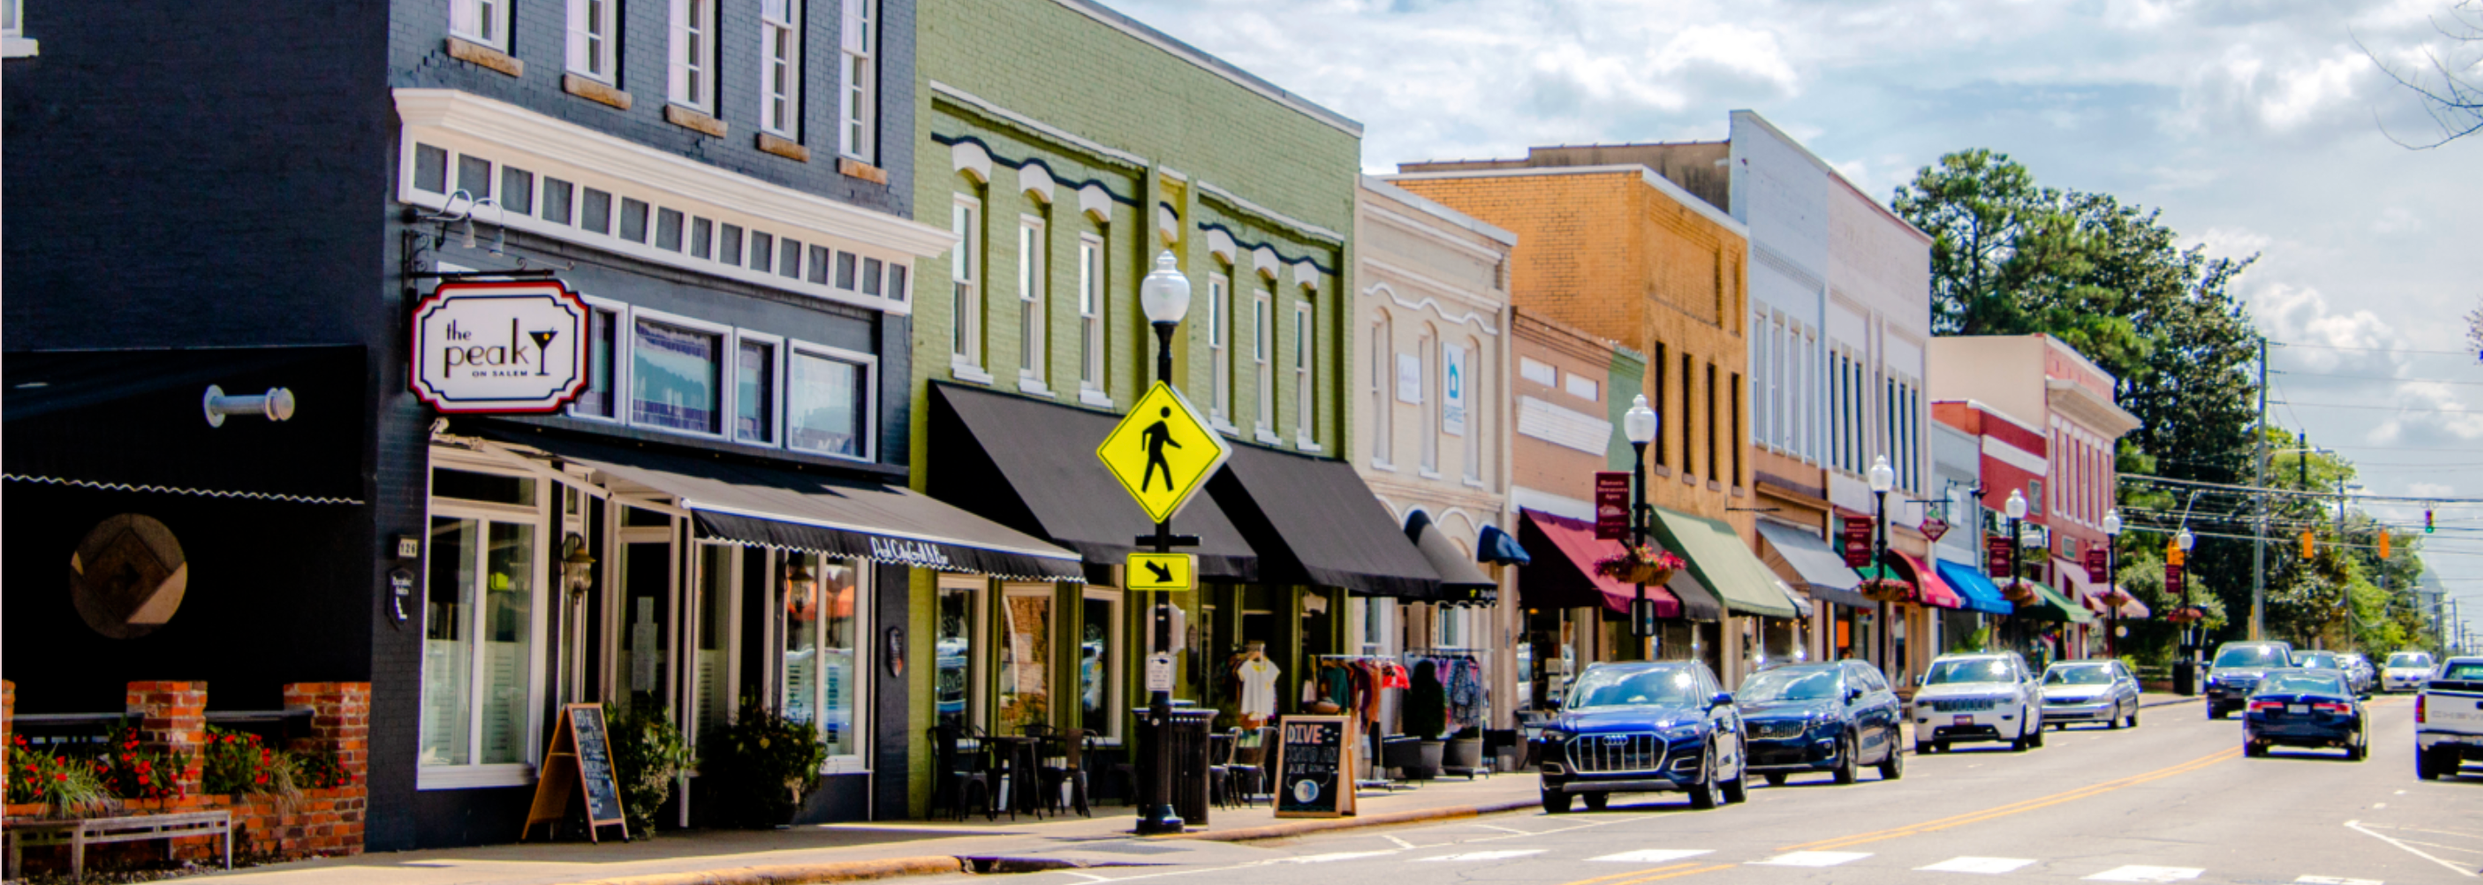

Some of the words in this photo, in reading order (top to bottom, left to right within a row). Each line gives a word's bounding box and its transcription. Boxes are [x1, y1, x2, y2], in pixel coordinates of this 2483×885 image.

[446, 319, 472, 341] the
[444, 317, 530, 379] peak
[400, 543, 416, 554] 126
[1286, 725, 1323, 744] DIVE
